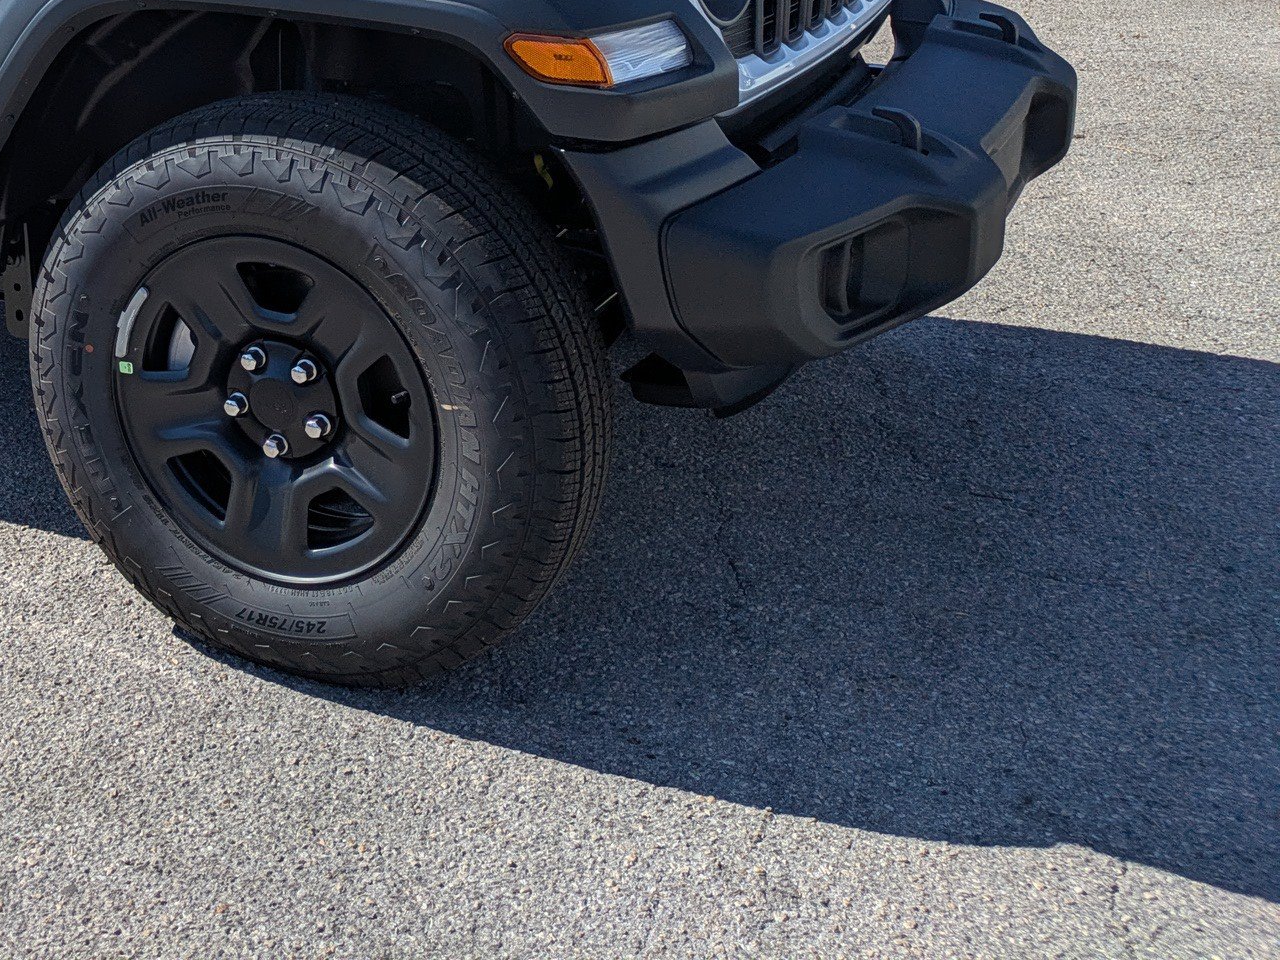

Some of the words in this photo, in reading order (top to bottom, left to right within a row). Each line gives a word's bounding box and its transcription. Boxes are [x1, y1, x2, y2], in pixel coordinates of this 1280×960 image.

[140, 191, 228, 227] All-Weather
[177, 204, 231, 219] Performance
[235, 607, 327, 633] 245/75R17
